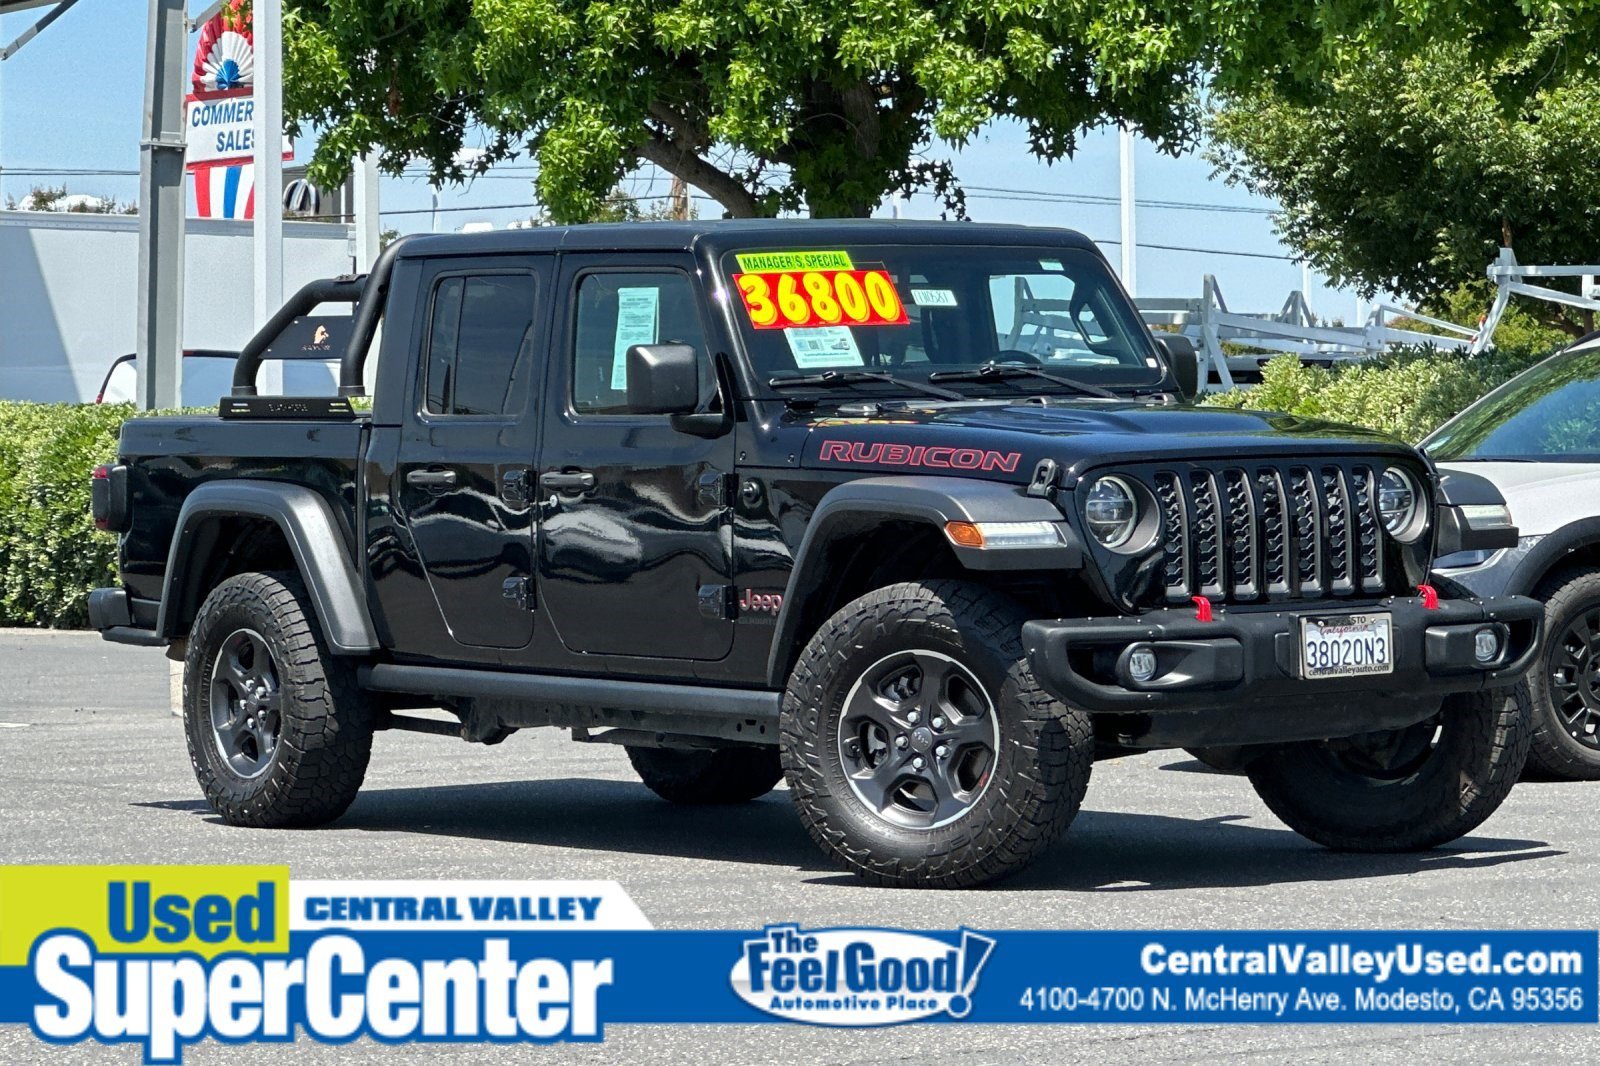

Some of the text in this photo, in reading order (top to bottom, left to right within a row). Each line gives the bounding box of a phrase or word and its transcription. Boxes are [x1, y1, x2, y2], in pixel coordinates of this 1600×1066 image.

[191, 100, 254, 127] COMMER
[742, 253, 848, 270] MANAGER'S SPECIAL
[738, 271, 900, 325] 36800
[819, 440, 1022, 472] RUBICON
[740, 588, 783, 616] Jeep
[1306, 638, 1386, 668] 38020N3
